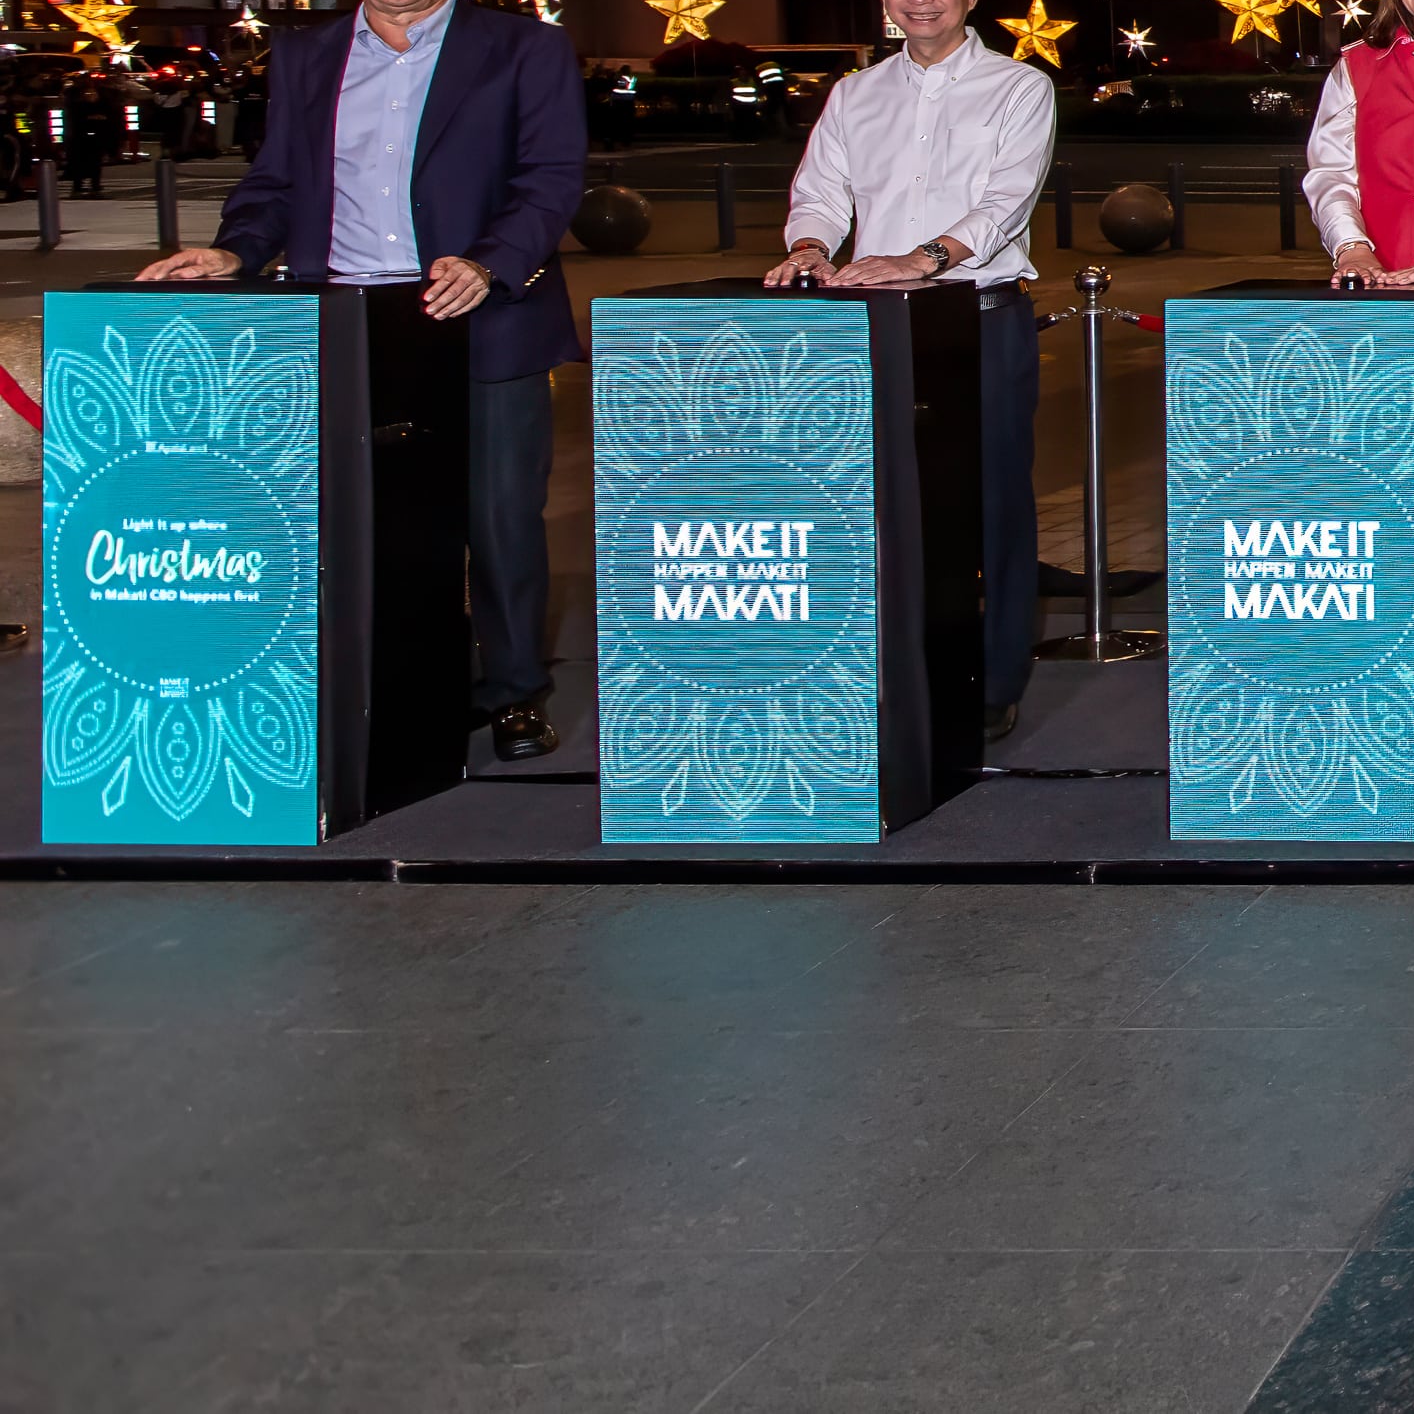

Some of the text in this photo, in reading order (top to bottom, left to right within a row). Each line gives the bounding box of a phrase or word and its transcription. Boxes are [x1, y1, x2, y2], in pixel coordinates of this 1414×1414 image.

[122, 517, 154, 532] Light
[157, 518, 168, 531] it
[86, 529, 269, 585] Christmas
[655, 562, 727, 579] HAPPEN
[1225, 561, 1296, 578] HAPPEN
[104, 587, 147, 602] Makati
[179, 589, 231, 604] happens
[233, 589, 260, 602] first
[654, 584, 809, 621] MAKATI
[1224, 583, 1375, 620] MAKATI
